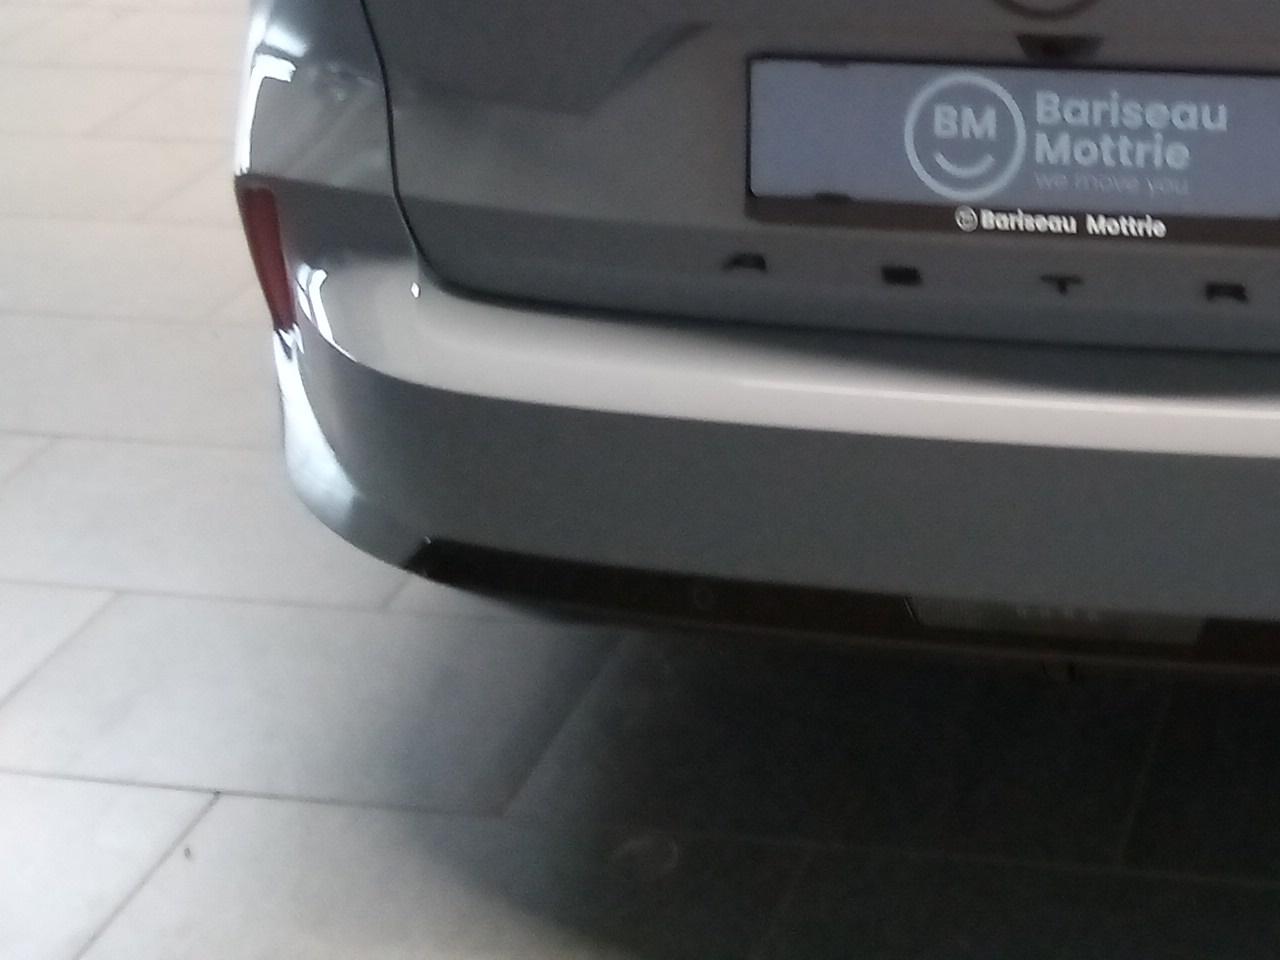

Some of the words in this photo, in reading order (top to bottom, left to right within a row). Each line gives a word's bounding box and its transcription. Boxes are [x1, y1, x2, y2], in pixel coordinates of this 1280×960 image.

[933, 103, 998, 140] BM
[1036, 90, 1228, 131] Bariseau
[1035, 131, 1191, 170] Mottrie
[980, 208, 1077, 234] Bariseau
[1086, 213, 1167, 238] Mottrie
